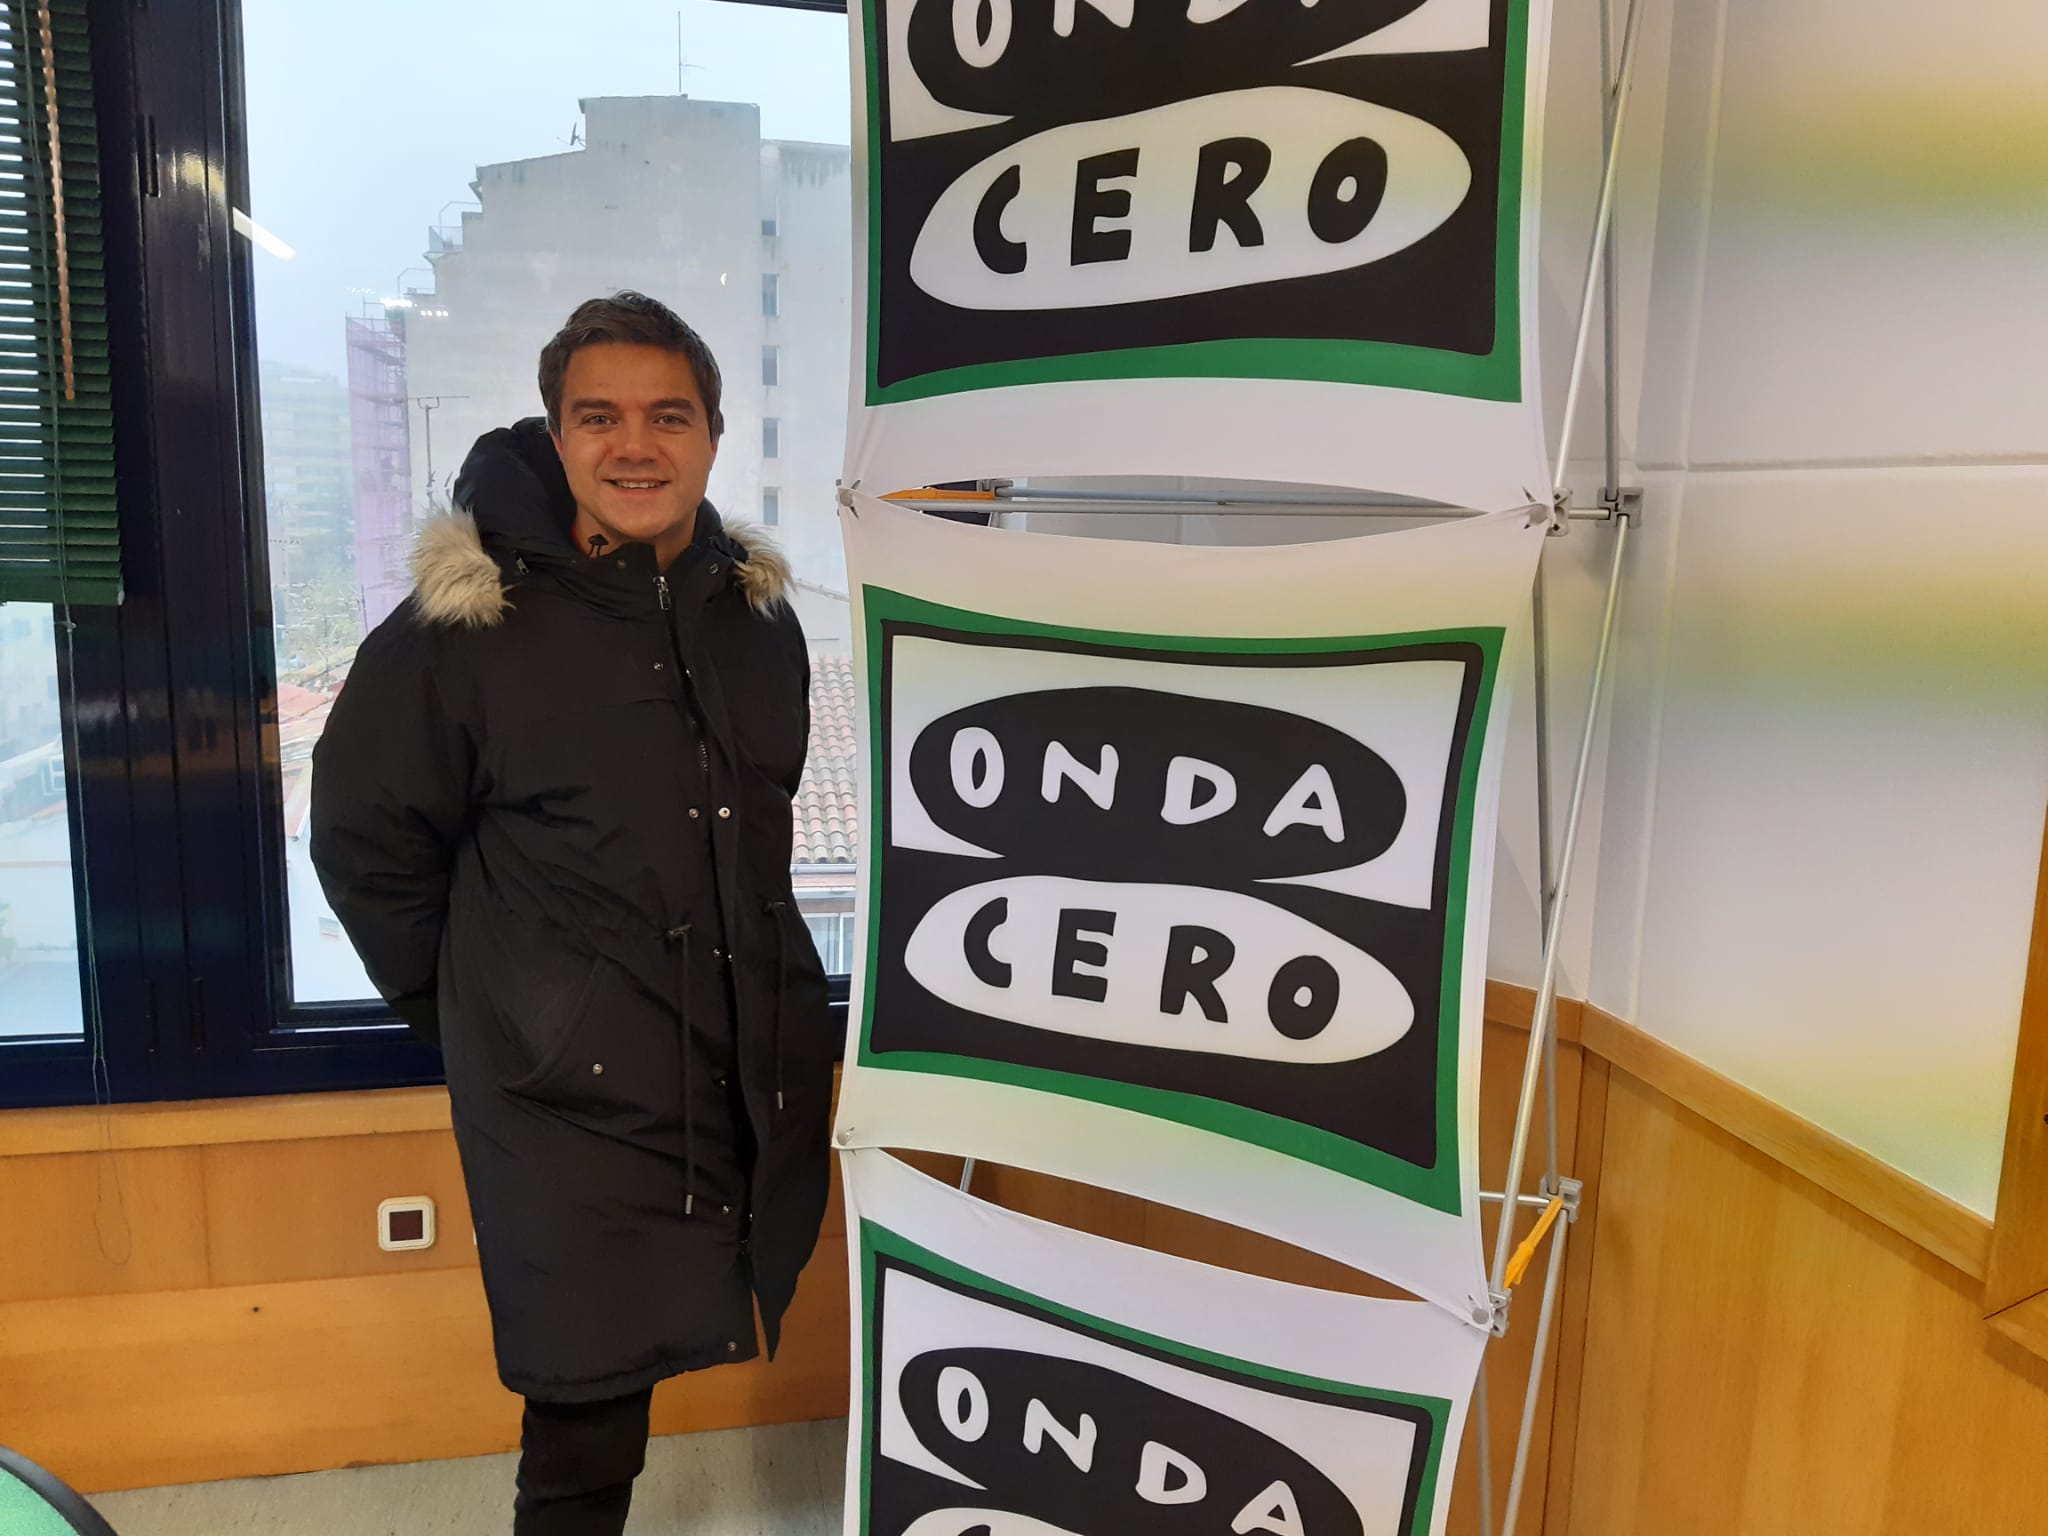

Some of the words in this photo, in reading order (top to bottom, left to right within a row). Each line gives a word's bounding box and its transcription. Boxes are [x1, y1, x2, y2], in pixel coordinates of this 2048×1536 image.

[973, 137, 1387, 274] CERO
[950, 727, 1344, 842] ONDA
[964, 897, 1339, 1040] CERO
[937, 1367, 1304, 1536] ONDA
